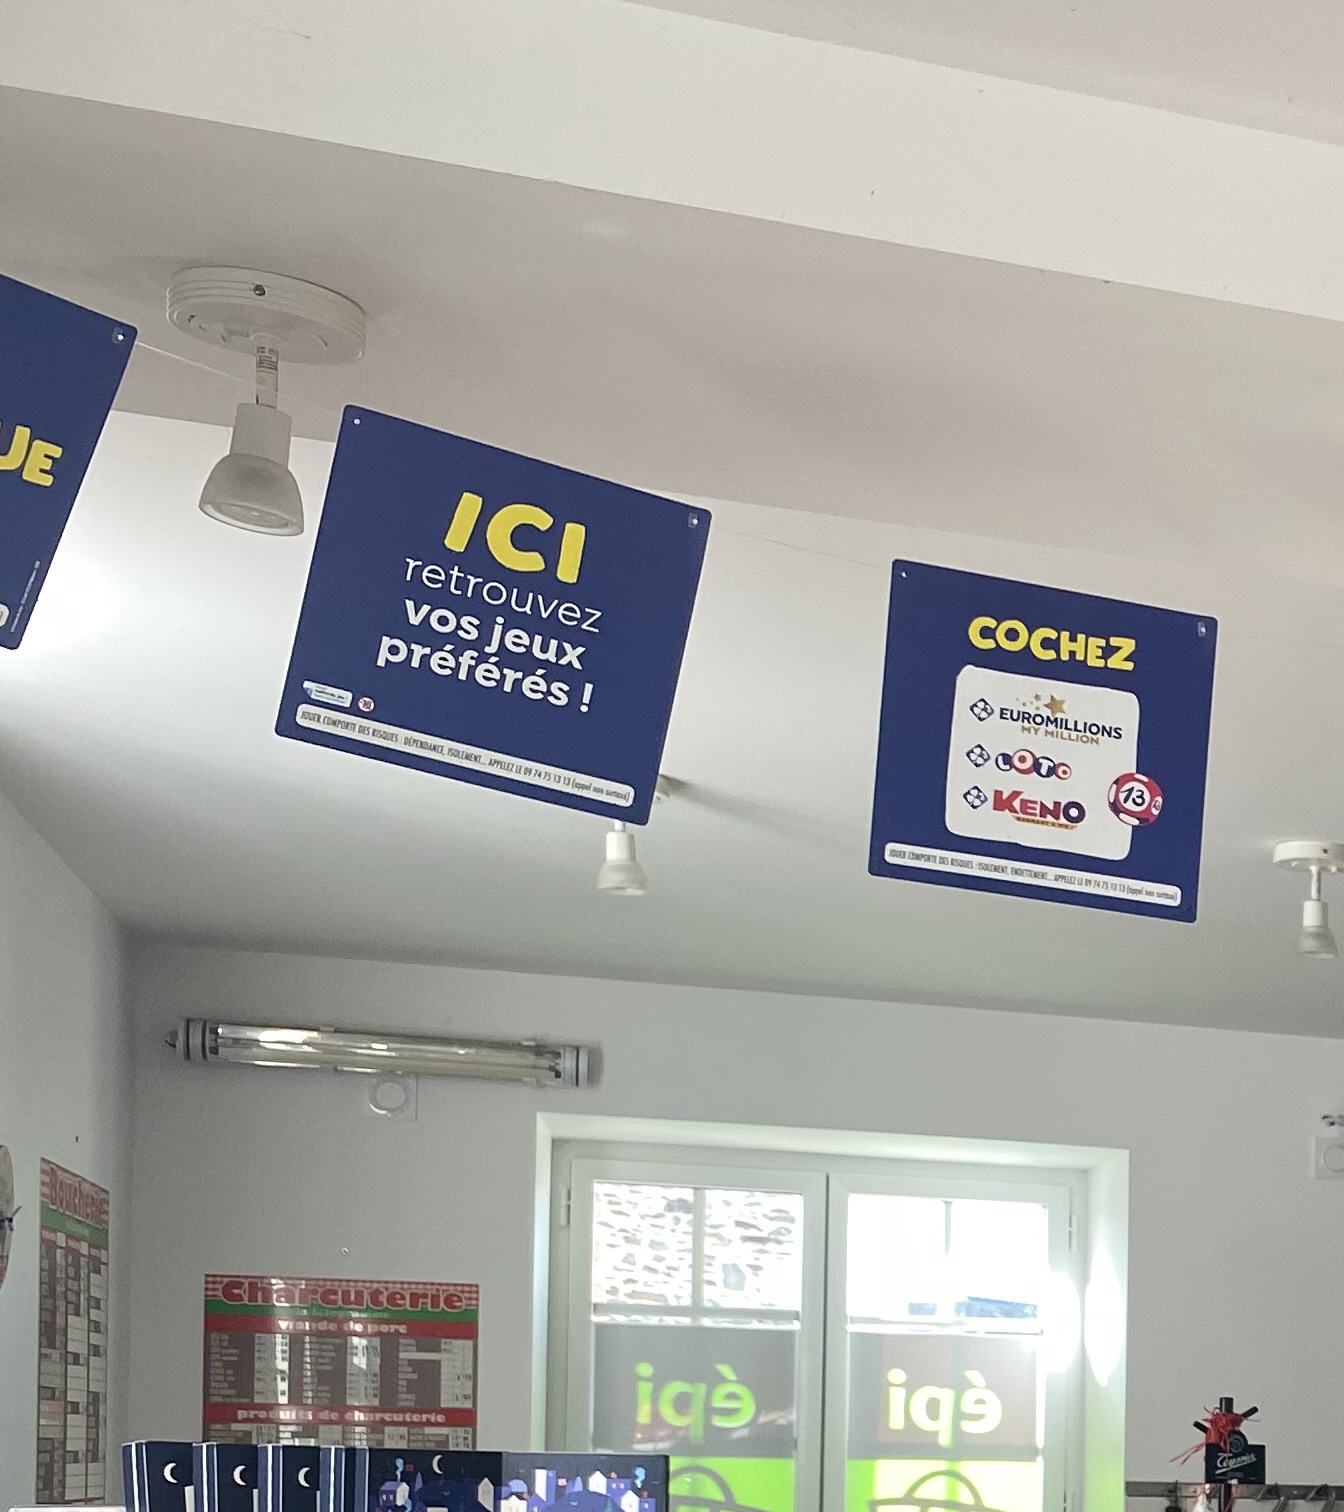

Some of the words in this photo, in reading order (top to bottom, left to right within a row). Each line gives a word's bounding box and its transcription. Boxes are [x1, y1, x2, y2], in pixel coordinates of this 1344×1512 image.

[444, 492, 586, 583] ICI
[405, 556, 602, 633] retrouvez
[405, 599, 480, 641] vos
[486, 617, 587, 670] jeux
[968, 616, 1136, 671] COCHEZ
[377, 633, 569, 708] préférés
[578, 682, 594, 713] !
[1000, 707, 1122, 739] EUROMILLIONS
[1021, 726, 1041, 735] MY
[1045, 731, 1099, 745] MILLION
[301, 711, 321, 723] JOUER
[323, 716, 357, 733] COMPORTE
[358, 725, 370, 735] DES
[372, 727, 398, 742] RISQUES
[488, 757, 514, 773] APPELEZ
[515, 764, 522, 774] LE
[524, 767, 532, 776] 09
[533, 769, 542, 779] 74
[543, 771, 550, 781] 75
[554, 773, 561, 783] 13
[563, 775, 570, 785] 13
[996, 749, 1072, 780] LOTO
[993, 789, 1086, 823] KENO
[1120, 787, 1145, 807] 13
[221, 1279, 465, 1312] Charcuterie
[369, 1323, 407, 1333] porc
[237, 1409, 313, 1421] produits
[319, 1410, 339, 1421] de
[345, 1410, 446, 1423] charcuterie
